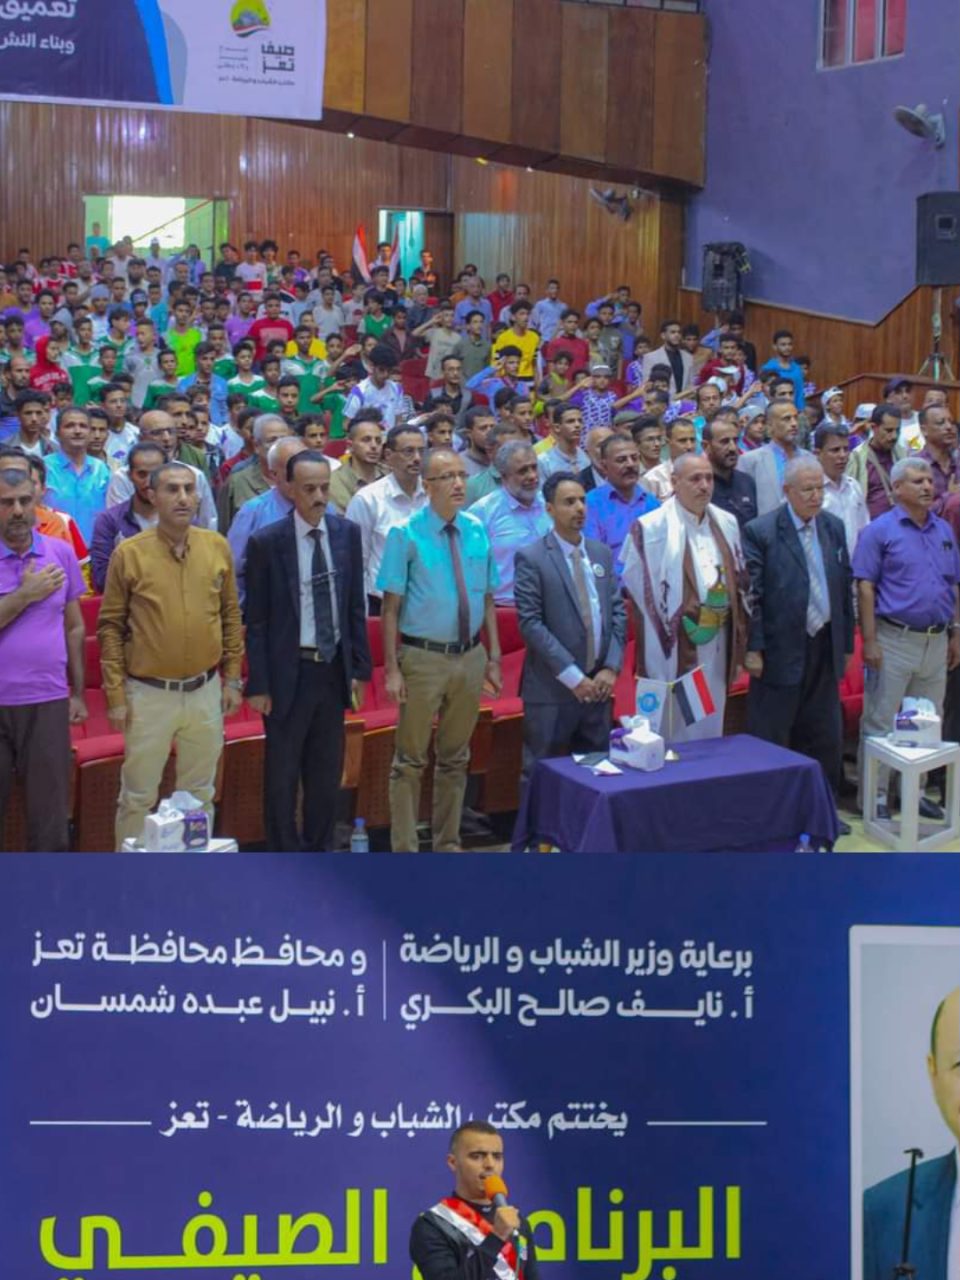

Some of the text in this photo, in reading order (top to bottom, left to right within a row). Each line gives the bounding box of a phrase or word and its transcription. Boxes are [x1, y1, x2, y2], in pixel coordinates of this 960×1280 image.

[40, 34, 75, 55] وبناء
[32, 930, 86, 967] تعز
[91, 930, 228, 966] محافظة
[231, 933, 345, 968] محافظ
[400, 932, 499, 973] الرياضة
[529, 937, 620, 974] الشباب
[624, 940, 674, 977] وزير
[679, 939, 753, 977] برعاية
[30, 982, 176, 1019] شمسان
[182, 992, 264, 1024] عبده
[269, 987, 336, 1025] نبيل
[401, 986, 512, 1031] البكري
[517, 988, 610, 1027] صالح
[616, 989, 724, 1027] نايف
[158, 1100, 210, 1137] تعز
[235, 1101, 342, 1138] الرياضة
[371, 1100, 463, 1138] الشباب
[547, 1101, 629, 1140] يختتم
